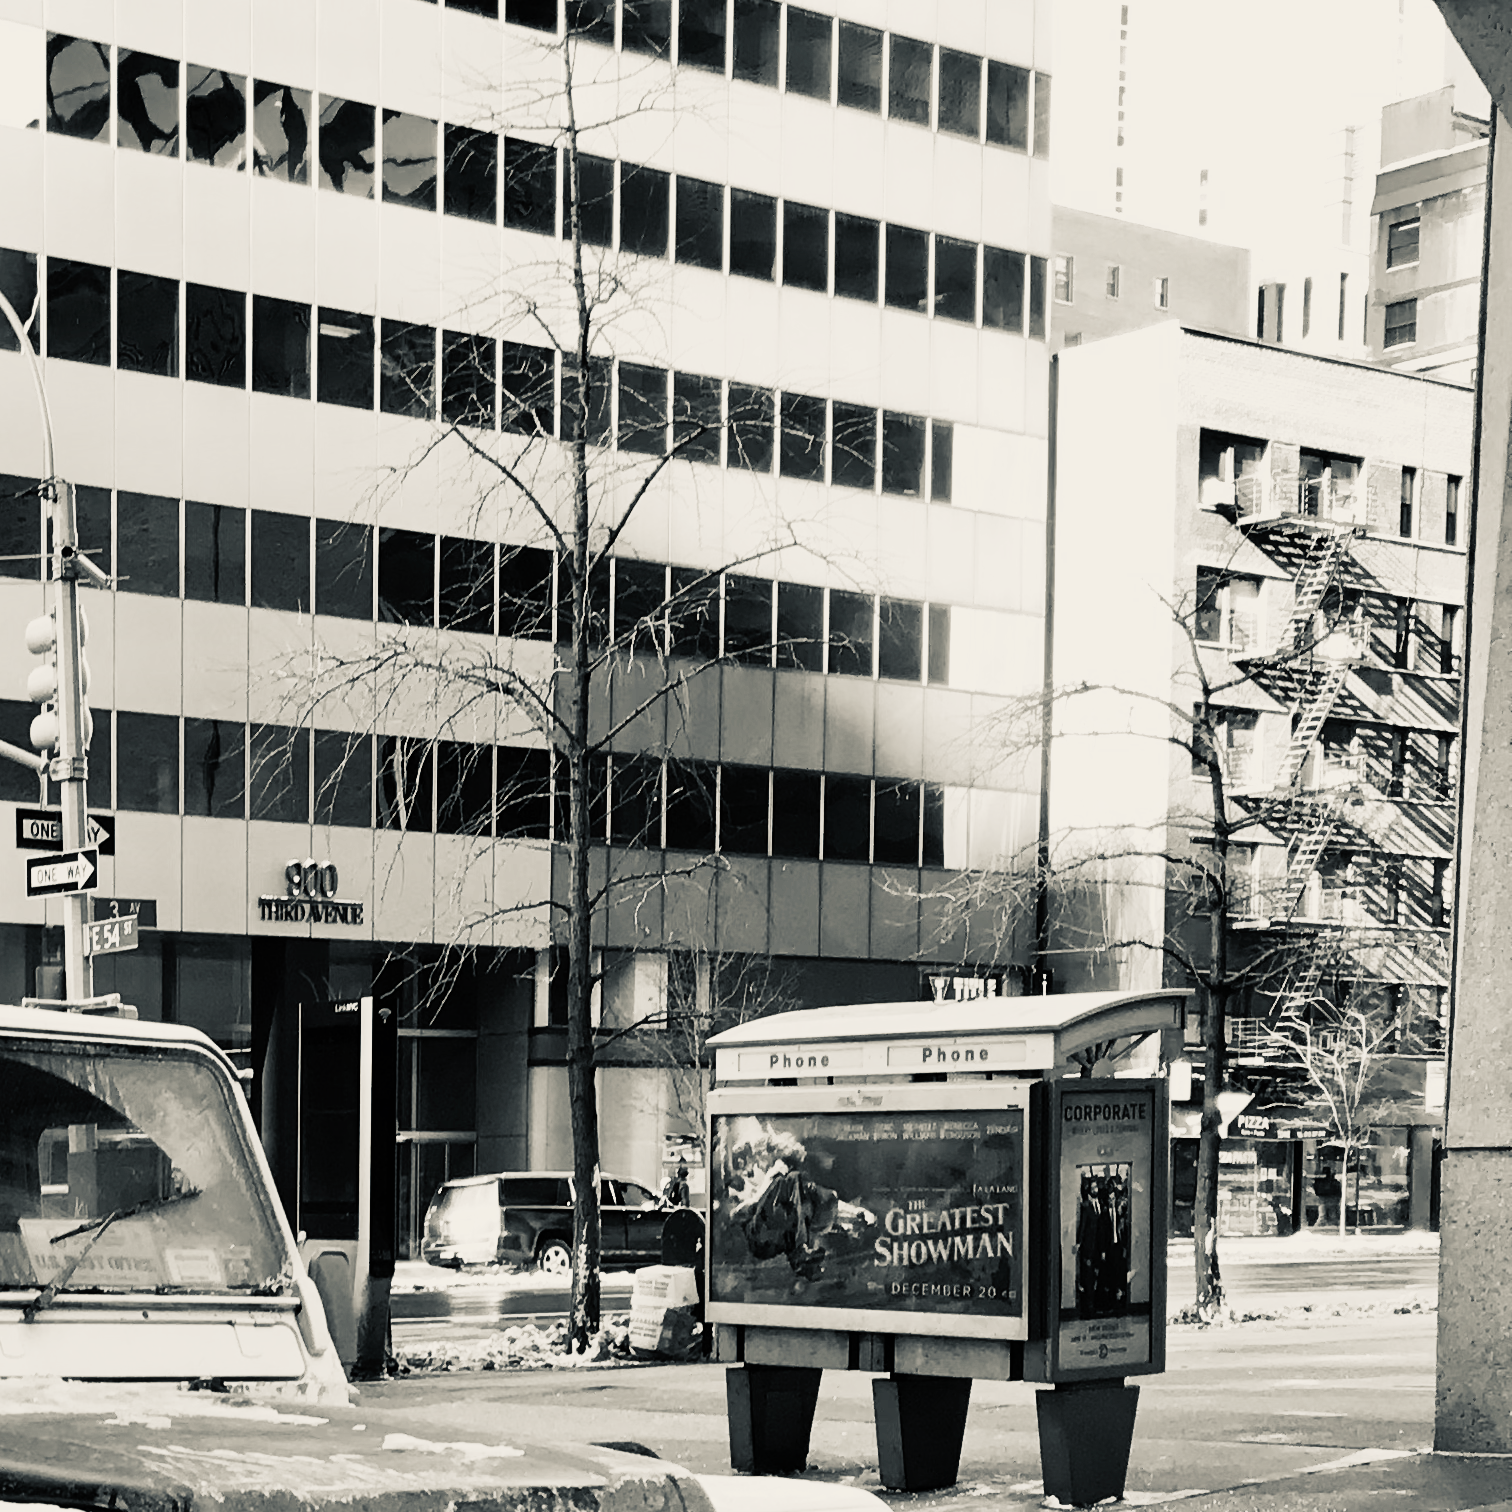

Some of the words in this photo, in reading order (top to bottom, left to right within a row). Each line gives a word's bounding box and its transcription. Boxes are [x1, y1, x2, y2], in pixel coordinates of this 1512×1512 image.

[30, 820, 58, 839] ONE
[37, 867, 58, 884] ONE
[66, 864, 88, 880] WAY
[285, 860, 338, 898] 900
[109, 901, 119, 918] 3
[258, 899, 306, 922] THIRD
[306, 901, 364, 925] AVENUE
[92, 926, 101, 951] E
[103, 923, 120, 950] 54
[123, 920, 133, 935] ST
[769, 1053, 830, 1069] Phone
[922, 1047, 989, 1063] Phone
[1064, 1102, 1146, 1121] CORPORATE
[1238, 1114, 1270, 1130] PIZZA
[885, 1203, 1010, 1236] GREATEST
[874, 1231, 1014, 1267] SHOWMAN
[891, 1281, 971, 1297] DECEMBER
[978, 1285, 997, 1299] 20
